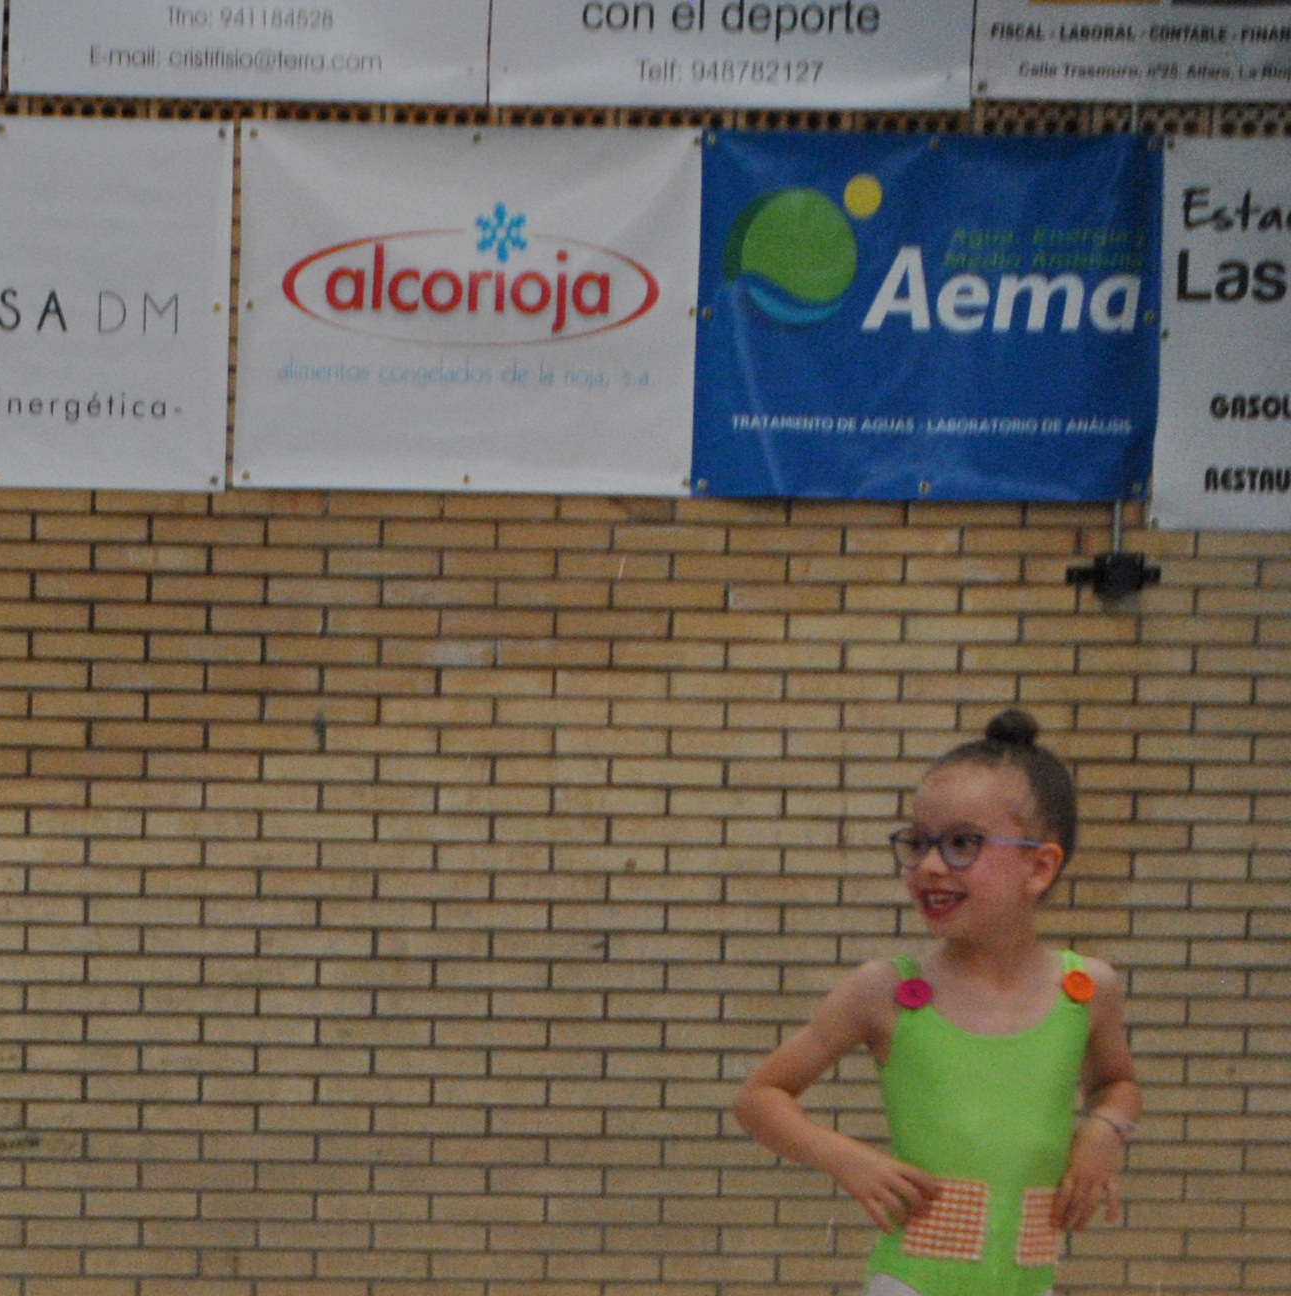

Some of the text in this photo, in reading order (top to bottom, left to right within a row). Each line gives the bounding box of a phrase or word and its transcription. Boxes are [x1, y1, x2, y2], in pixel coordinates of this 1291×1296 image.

[582, 0, 881, 42] con el deporte
[990, 21, 1046, 41] FISCAL
[1180, 186, 1291, 233] Esta
[324, 243, 611, 334] alcorioja
[860, 245, 1143, 333] Aema
[1176, 248, 1288, 303] Las
[97, 289, 180, 335] DM
[732, 414, 834, 432] TRATAMIENTO
[836, 415, 857, 433] DE
[861, 416, 915, 433] AGUAS
[926, 417, 1039, 435] LABORATORIO
[1041, 418, 1063, 435] DE
